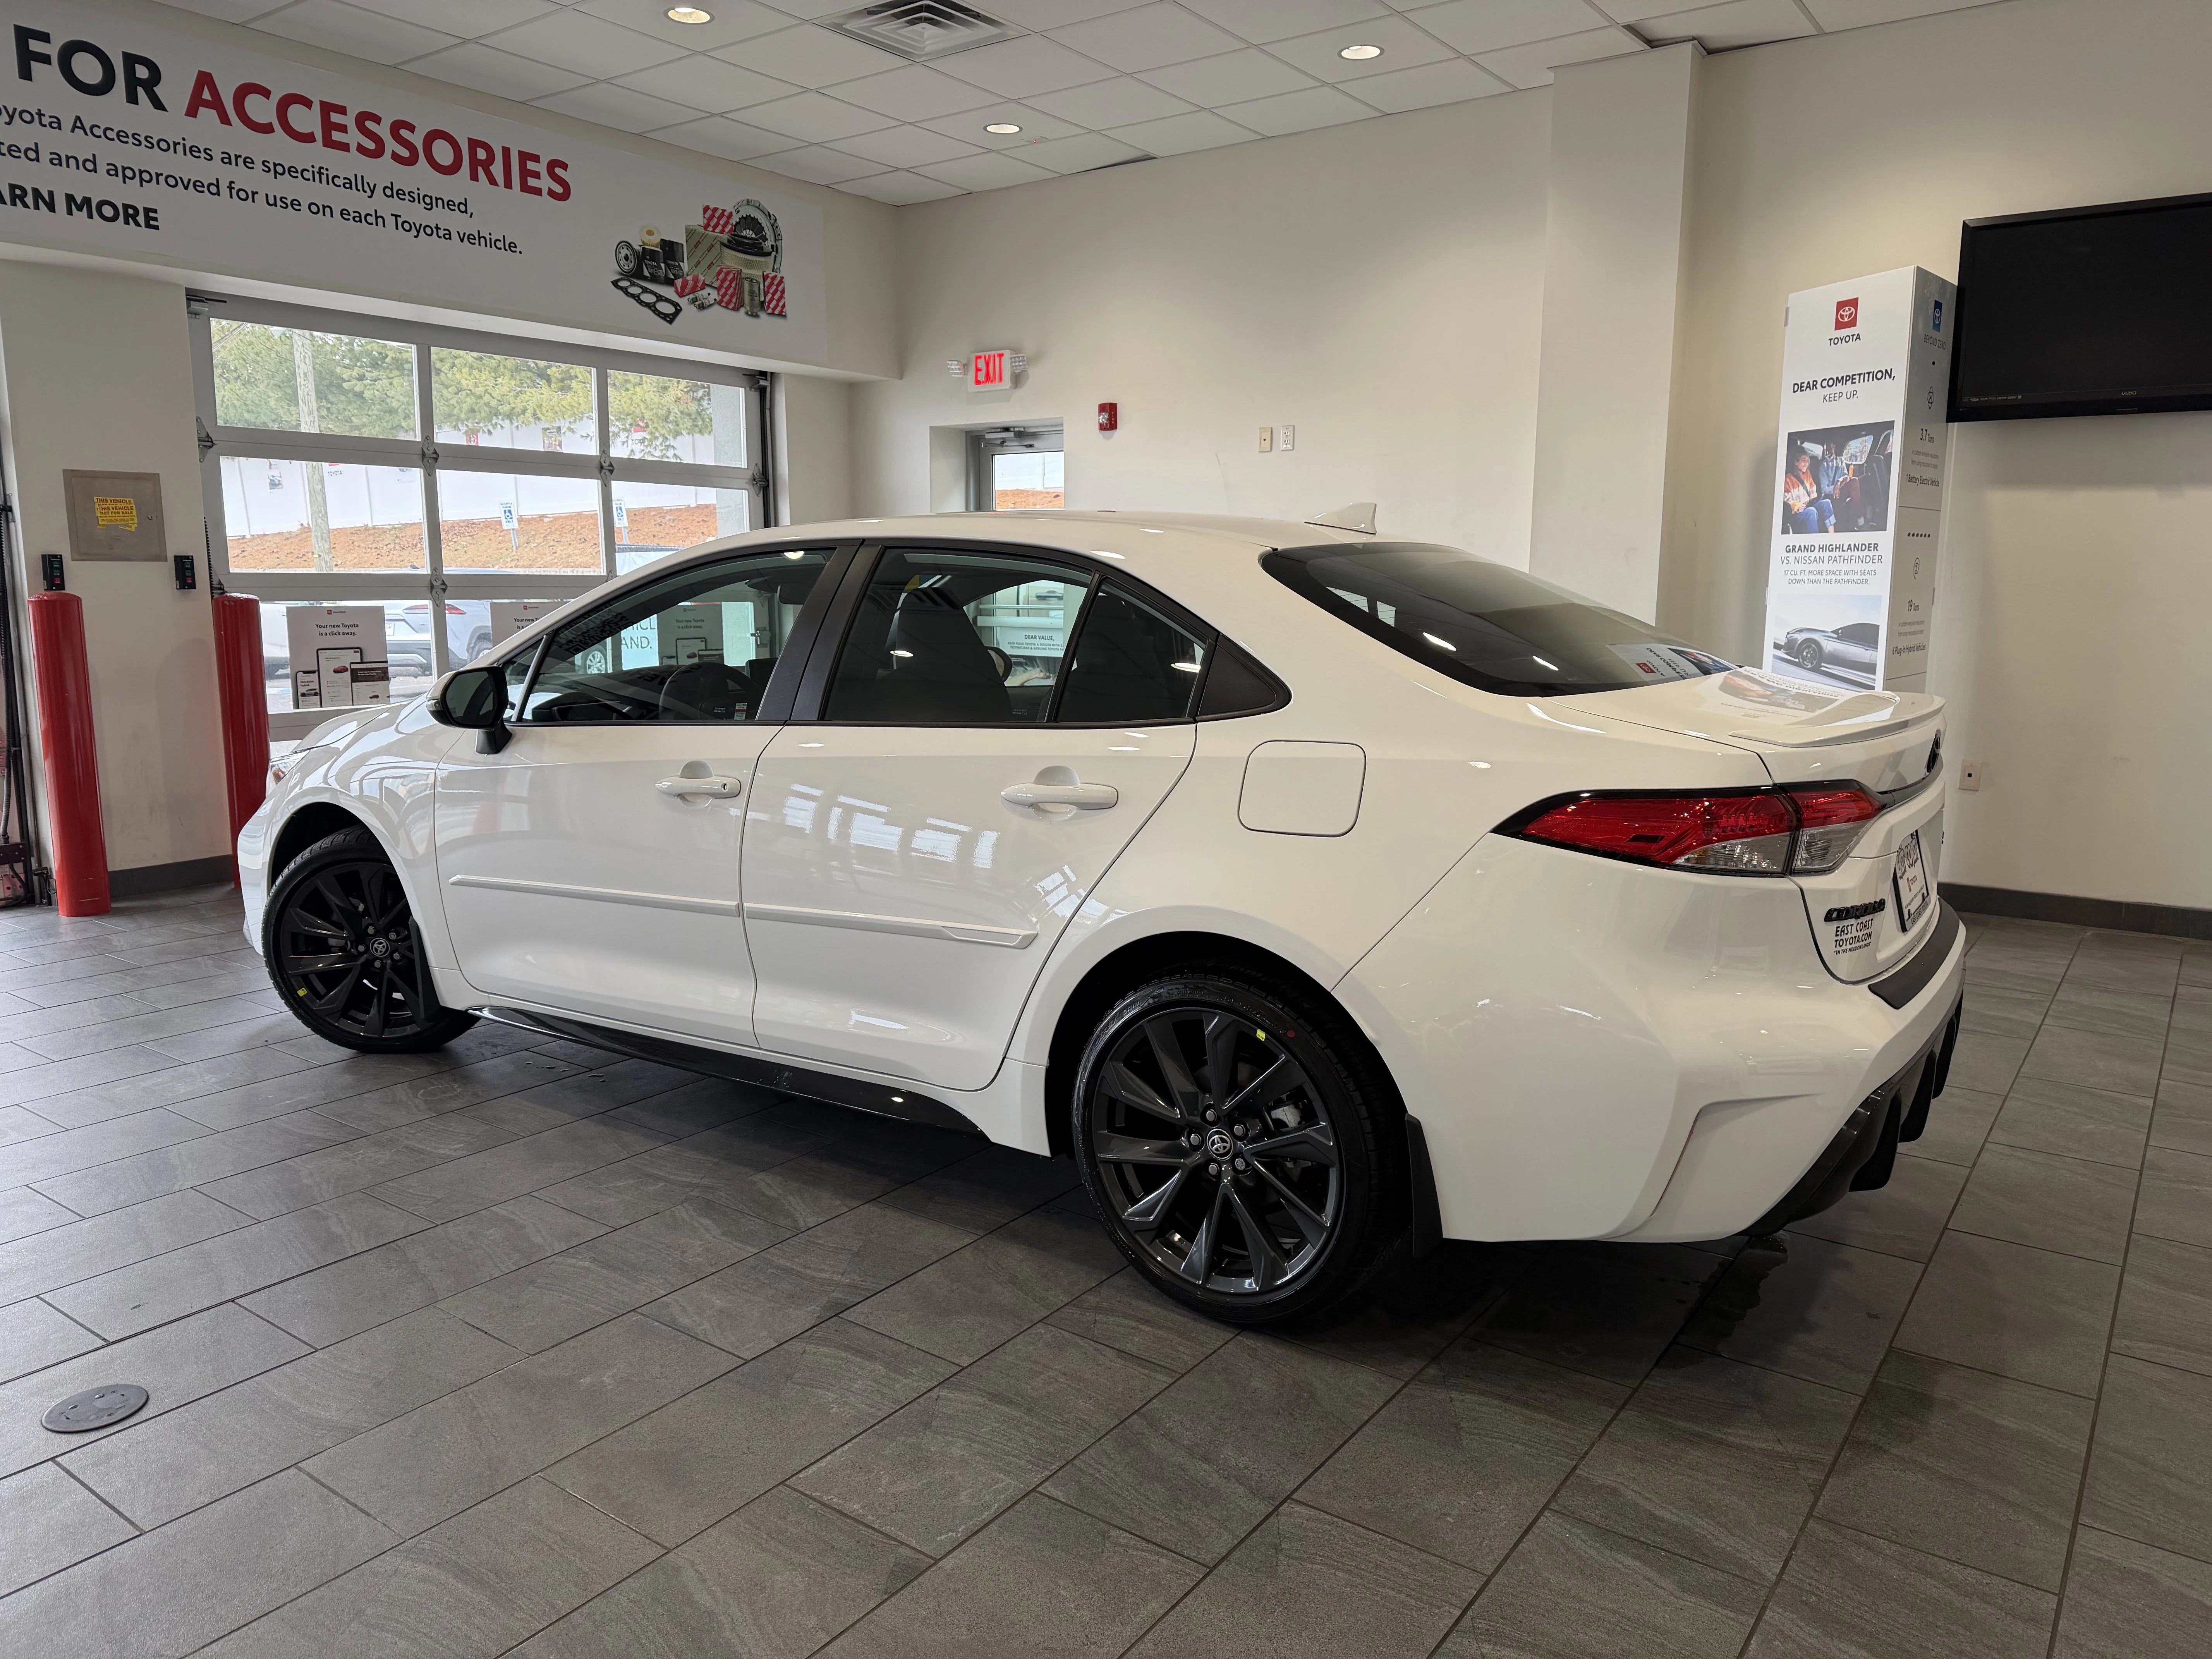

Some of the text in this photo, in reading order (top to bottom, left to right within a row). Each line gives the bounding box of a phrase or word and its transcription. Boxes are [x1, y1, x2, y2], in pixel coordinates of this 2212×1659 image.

[13, 24, 572, 201] FOR ACCESSORIES
[0, 104, 474, 218] yota Accessories are specifically designed,
[49, 151, 98, 173] and
[105, 162, 221, 197] approved
[227, 180, 259, 204] for
[265, 193, 302, 212] use
[307, 201, 334, 218] on
[340, 206, 386, 228] each
[390, 213, 452, 241] Toyota
[456, 230, 523, 254] vehicle.
[65, 192, 160, 230] MORE
[1828, 333, 1861, 346] TOYOTA
[1937, 339, 1946, 350] ZERO
[974, 353, 1005, 385] EXIT
[1793, 368, 1896, 393] DEAR COMPETITION,
[1823, 390, 1859, 403] KEEP UP.
[1908, 474, 1919, 486] Battery
[1919, 475, 1930, 486] Electric
[1785, 543, 1879, 553] GRAND HIGHLANDER
[1781, 555, 1882, 565] VS. NISSAN PATHFINDER
[1835, 918, 1874, 937] EAST COAST
[1834, 931, 1872, 948] TOYOTA.COM
